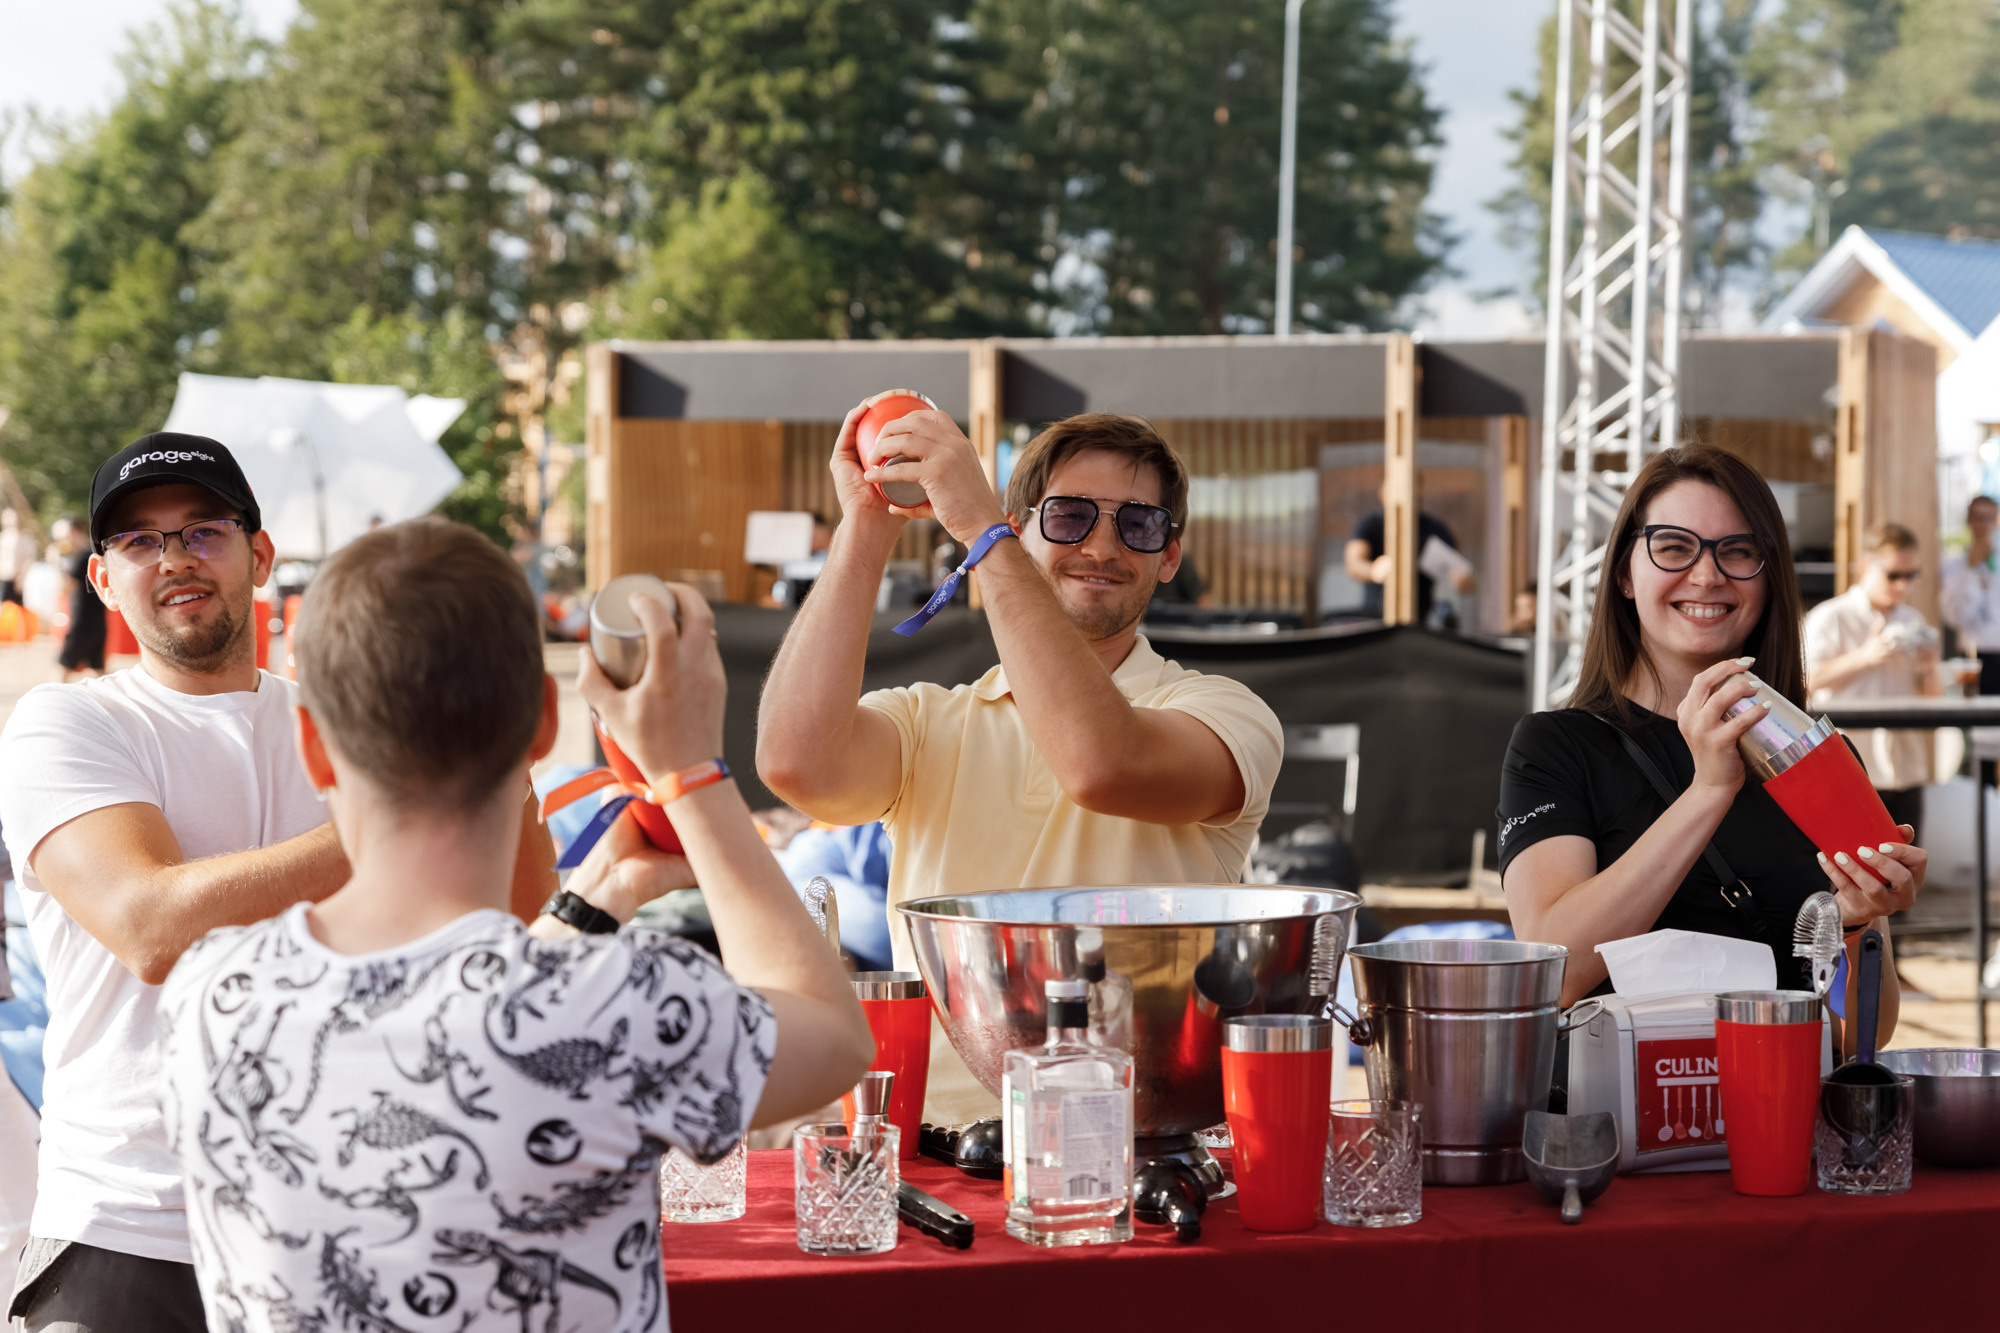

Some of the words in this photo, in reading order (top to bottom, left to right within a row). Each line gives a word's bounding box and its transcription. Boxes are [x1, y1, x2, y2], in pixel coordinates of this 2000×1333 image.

[119, 450, 192, 480] garage
[1534, 802, 1556, 813] eight
[1655, 1056, 1719, 1076] CULIN
